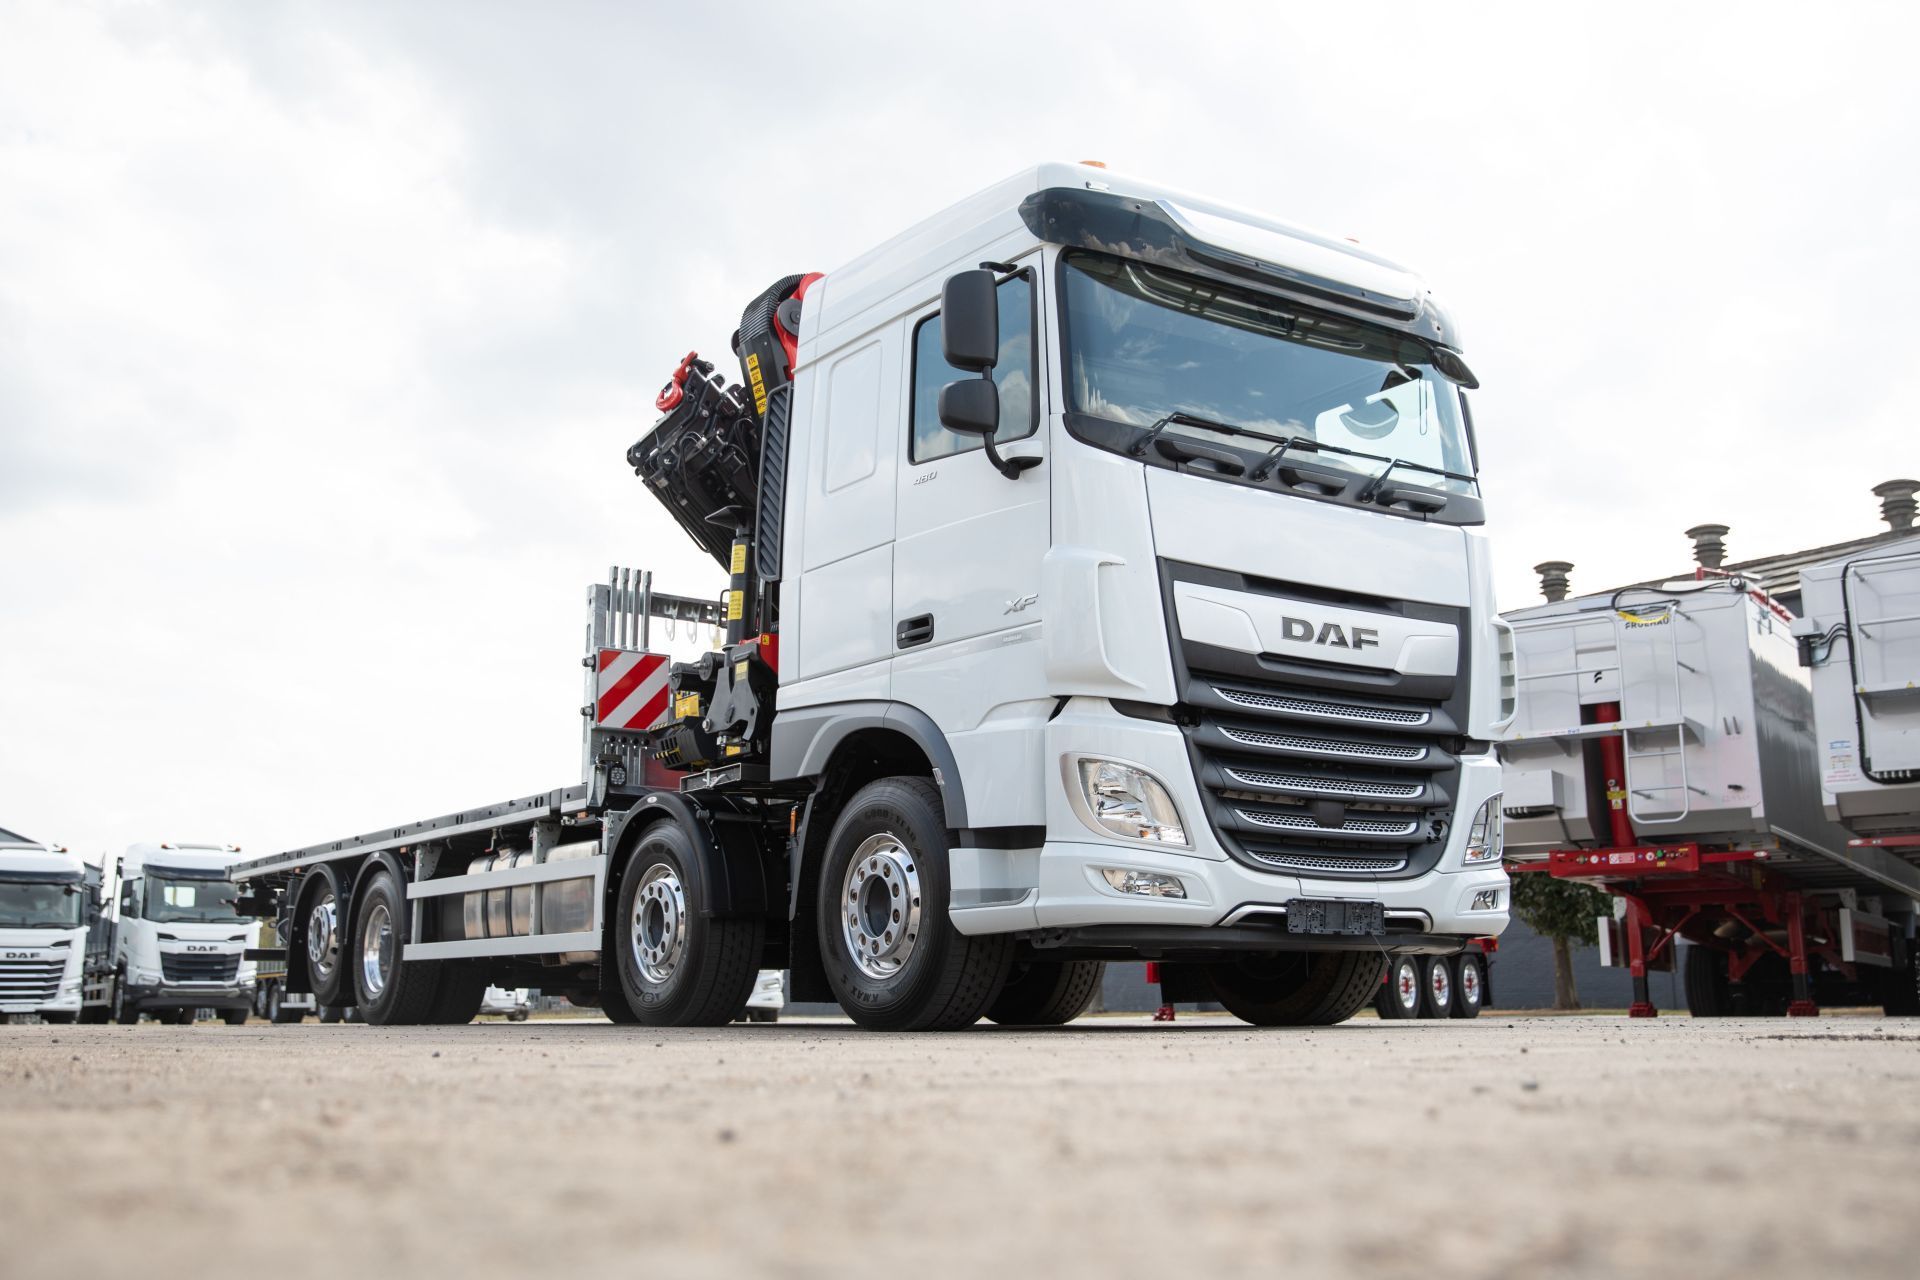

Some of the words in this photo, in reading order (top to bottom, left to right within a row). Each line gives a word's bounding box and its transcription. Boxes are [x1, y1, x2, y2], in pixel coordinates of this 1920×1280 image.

[913, 471, 938, 486] 480
[1003, 592, 1039, 615] XF
[1281, 615, 1379, 650] DAF
[850, 986, 879, 1002] KMAX
